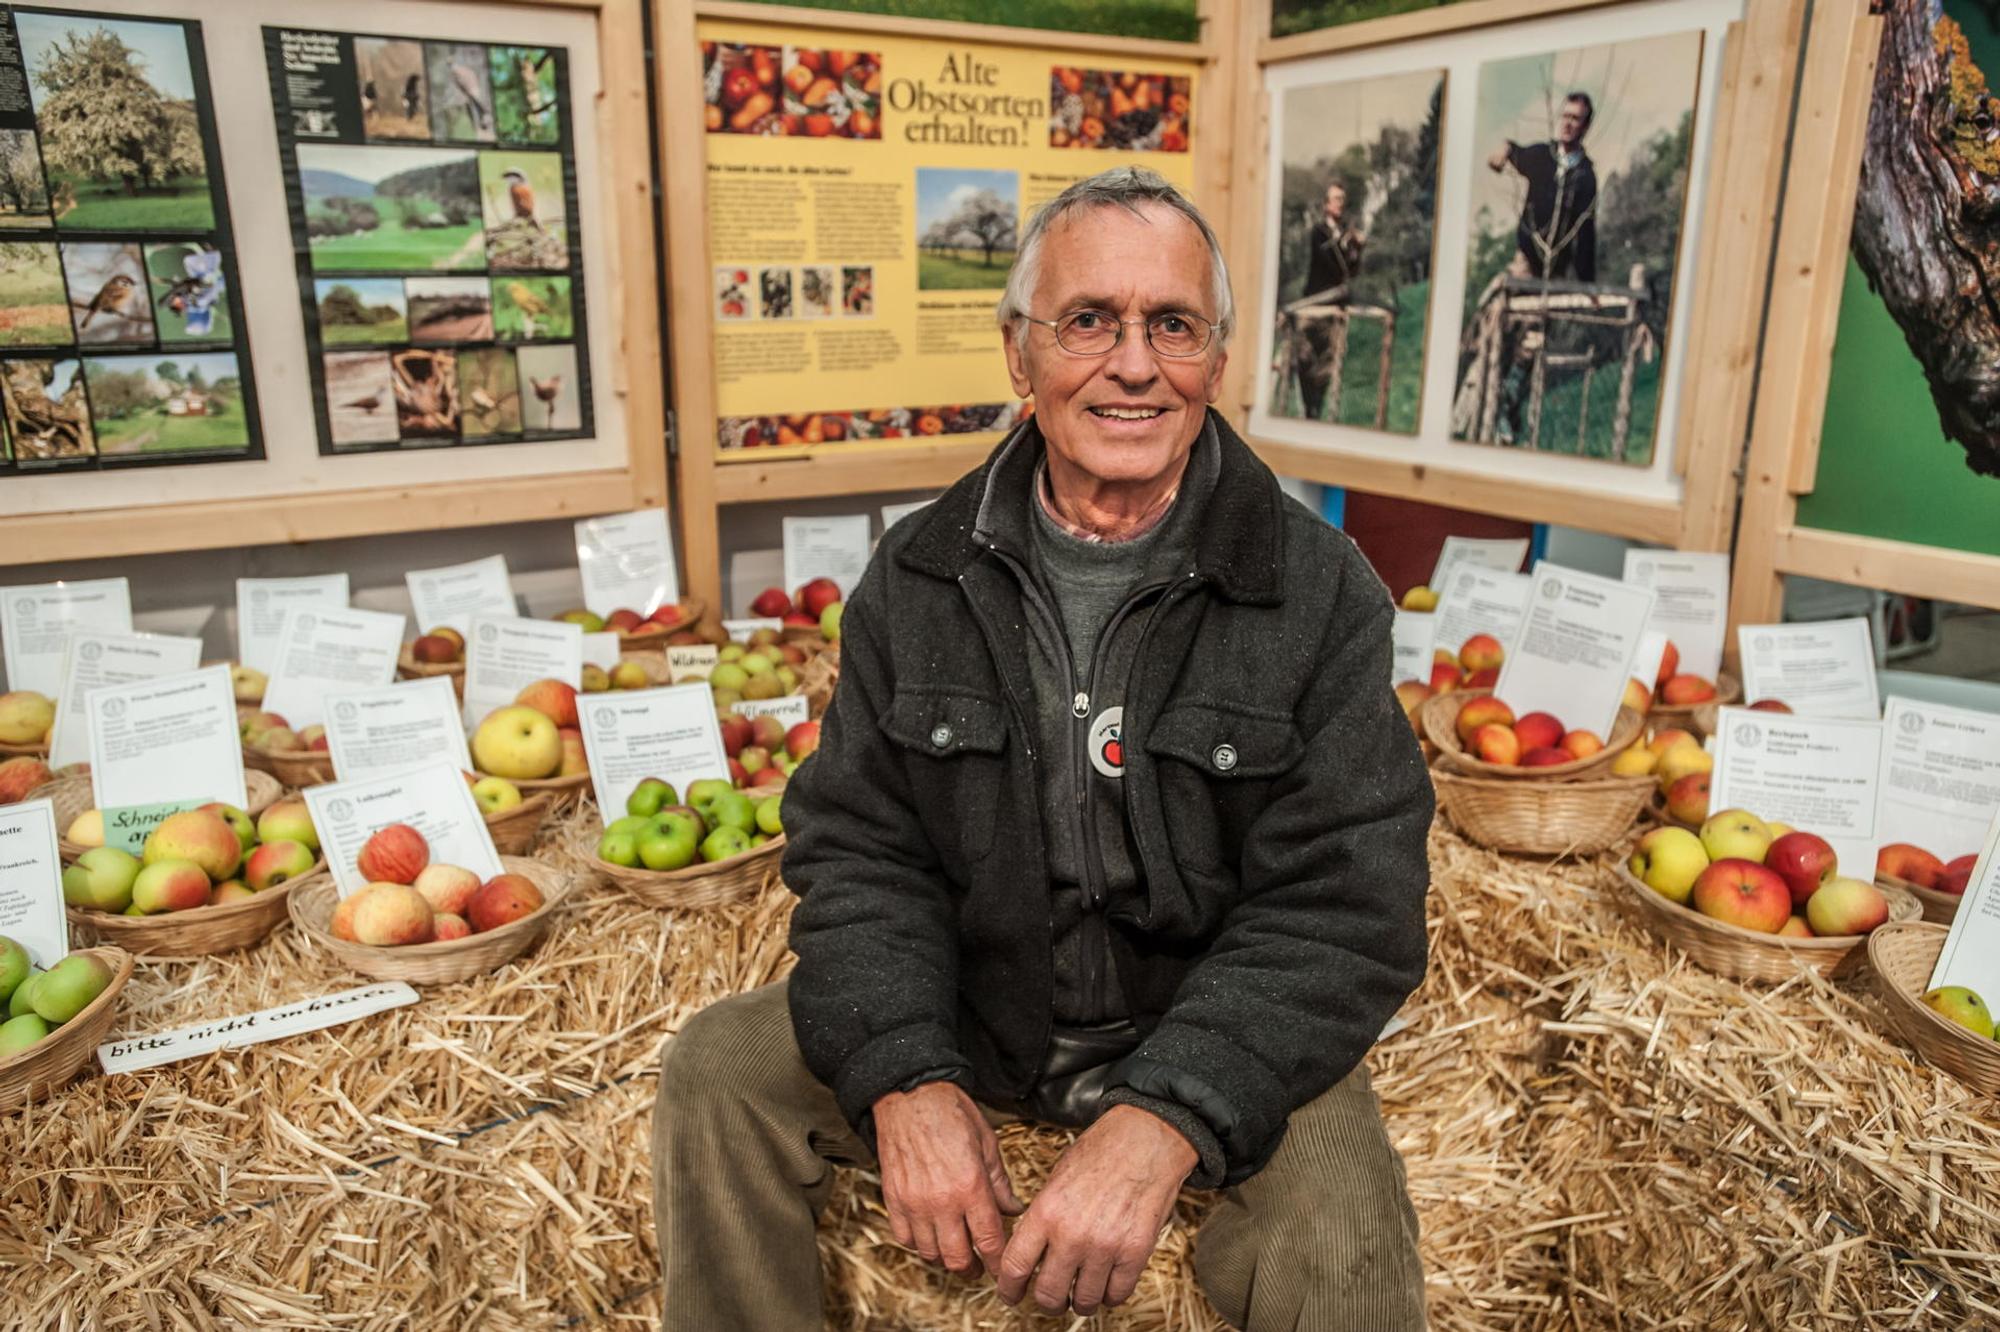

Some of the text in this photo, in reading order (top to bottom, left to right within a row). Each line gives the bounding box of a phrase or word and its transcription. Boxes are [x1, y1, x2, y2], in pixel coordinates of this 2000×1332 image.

[938, 52, 998, 87] Alte
[888, 78, 1045, 118] Obstsorten
[905, 114, 1029, 147] erhalten!
[112, 806, 187, 829] Schneid
[111, 1037, 176, 1058] bitte
[188, 1015, 256, 1041] nicht
